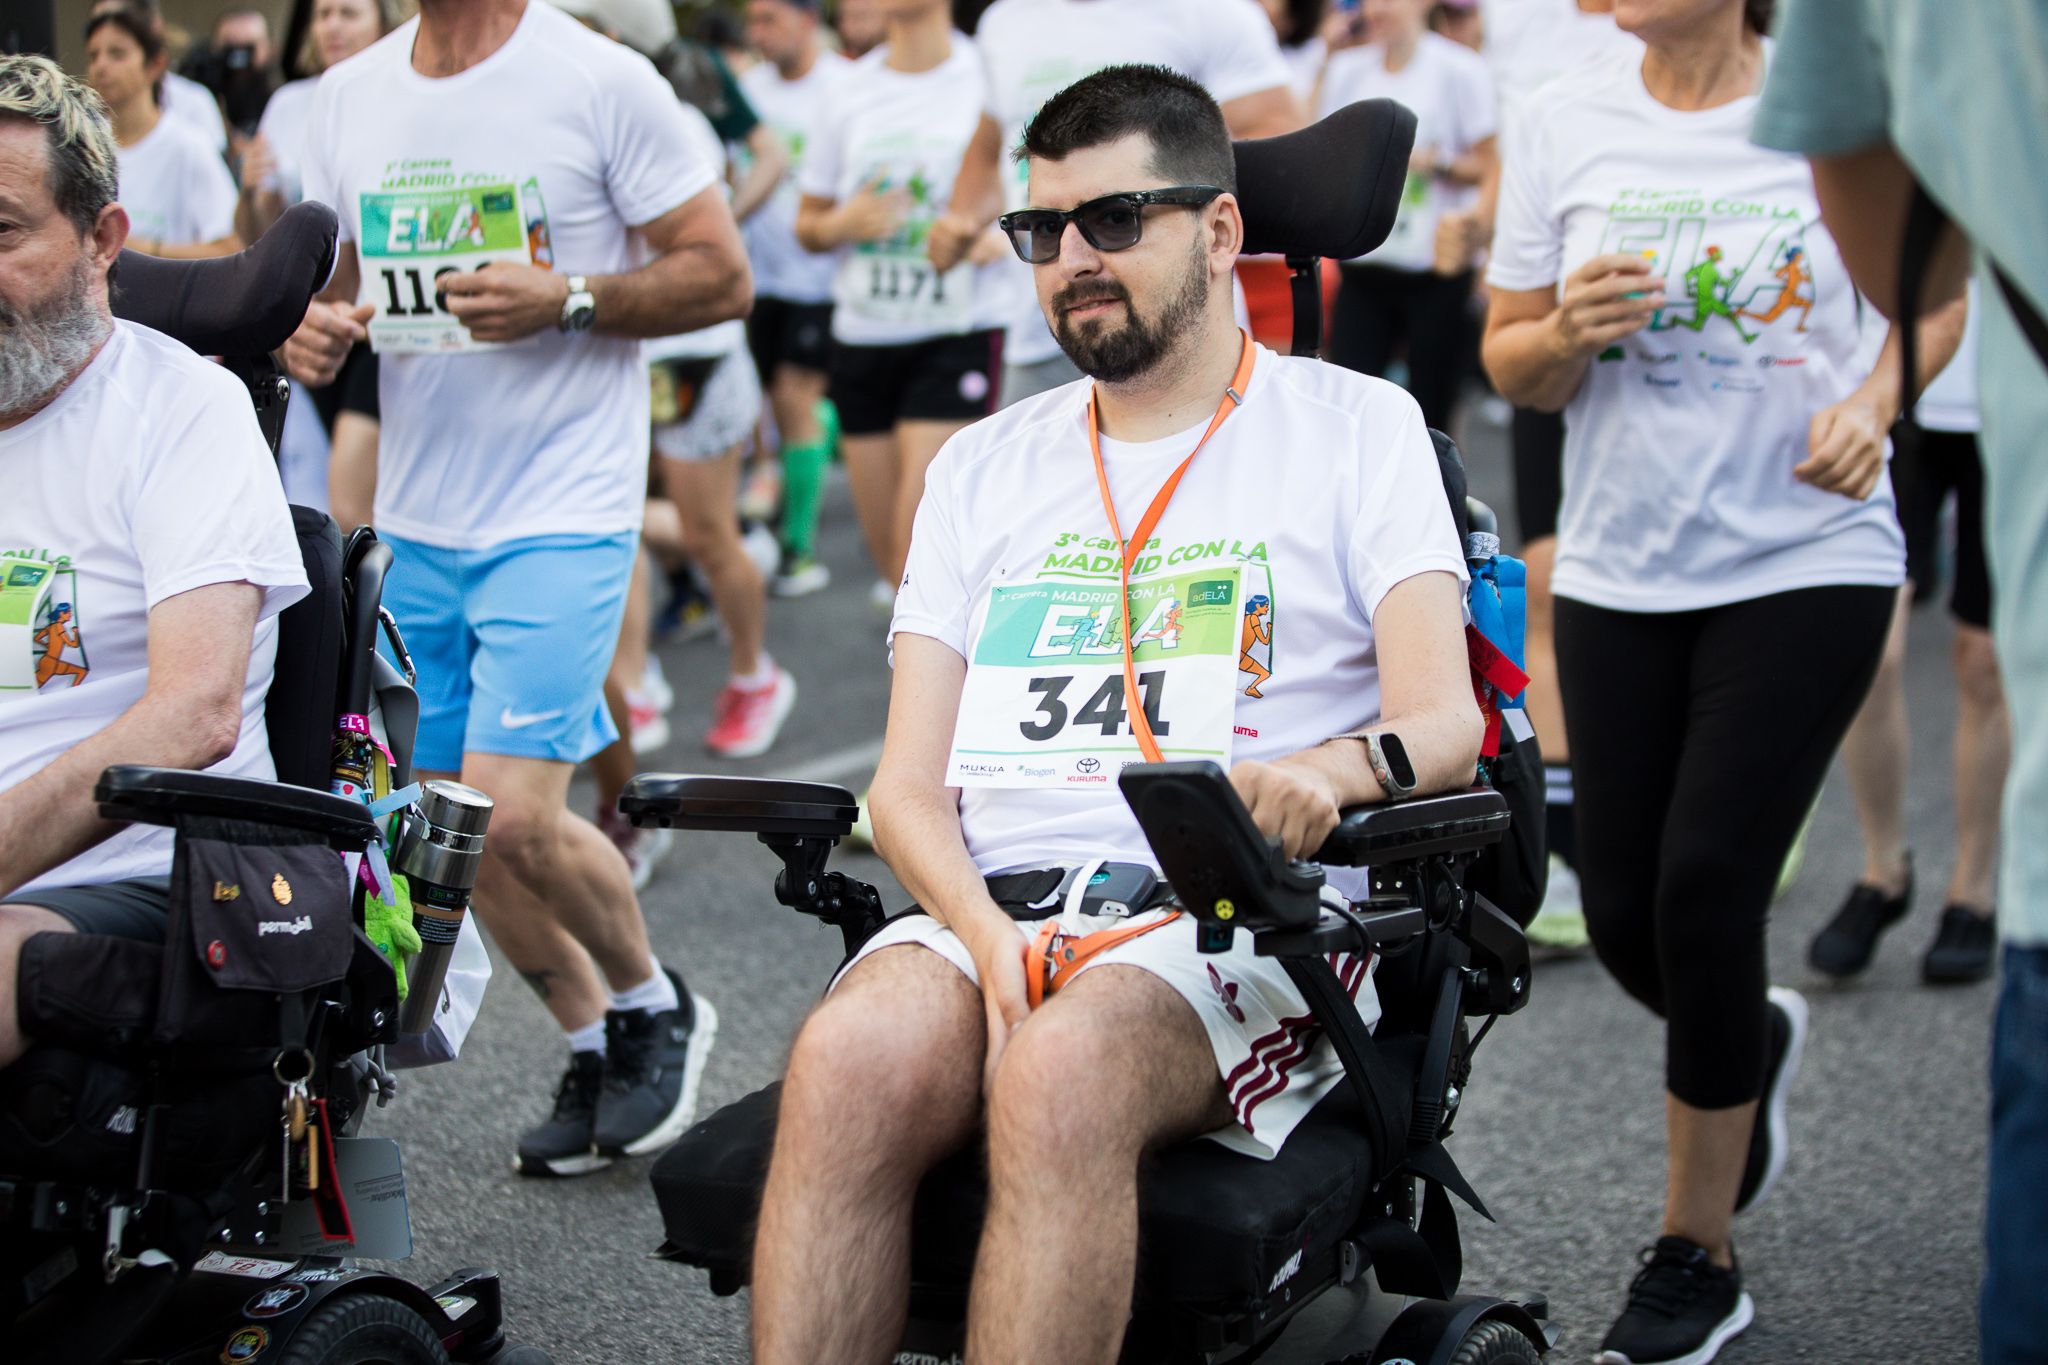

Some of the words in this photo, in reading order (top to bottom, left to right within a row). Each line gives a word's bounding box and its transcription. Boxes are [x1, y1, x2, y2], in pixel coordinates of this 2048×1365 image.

[1711, 197, 1765, 217] CON
[386, 202, 485, 253] ELA
[1054, 532, 1080, 547] 3ª
[1167, 538, 1226, 566] CON
[1230, 539, 1268, 561] LA
[1051, 590, 1119, 603] MADRID
[1157, 583, 1176, 596] LA
[1027, 597, 1180, 659] ELA
[1019, 670, 1170, 742] 341
[1233, 725, 1259, 738] uma
[960, 764, 1005, 772] MUKUA
[1024, 768, 1056, 778] Biogen
